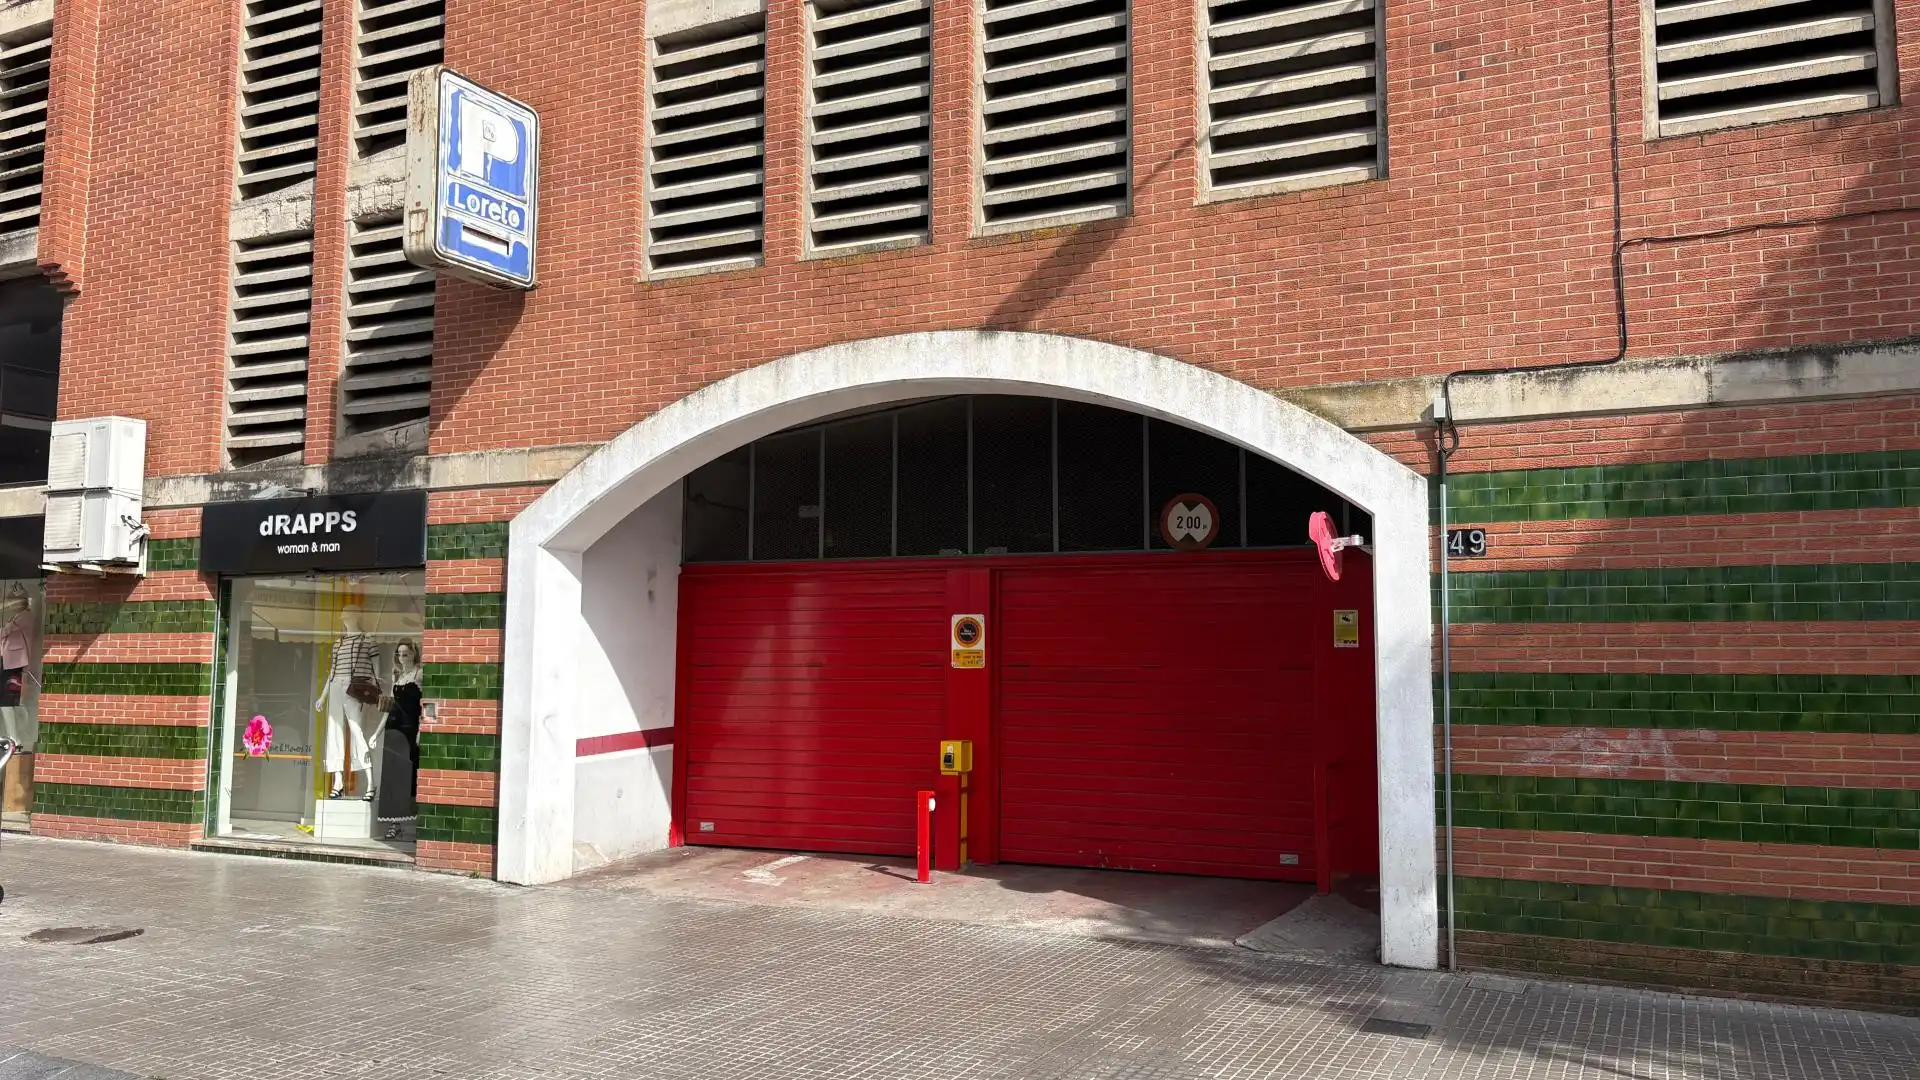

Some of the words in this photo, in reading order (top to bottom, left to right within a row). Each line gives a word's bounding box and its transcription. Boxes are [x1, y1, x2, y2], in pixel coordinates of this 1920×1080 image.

[460, 97, 518, 180] P
[454, 184, 520, 227] Loreto
[259, 510, 357, 537] dRAPPS
[277, 543, 309, 554] woman
[311, 541, 318, 553] &
[320, 541, 341, 553] man
[1450, 530, 1485, 553] 49
